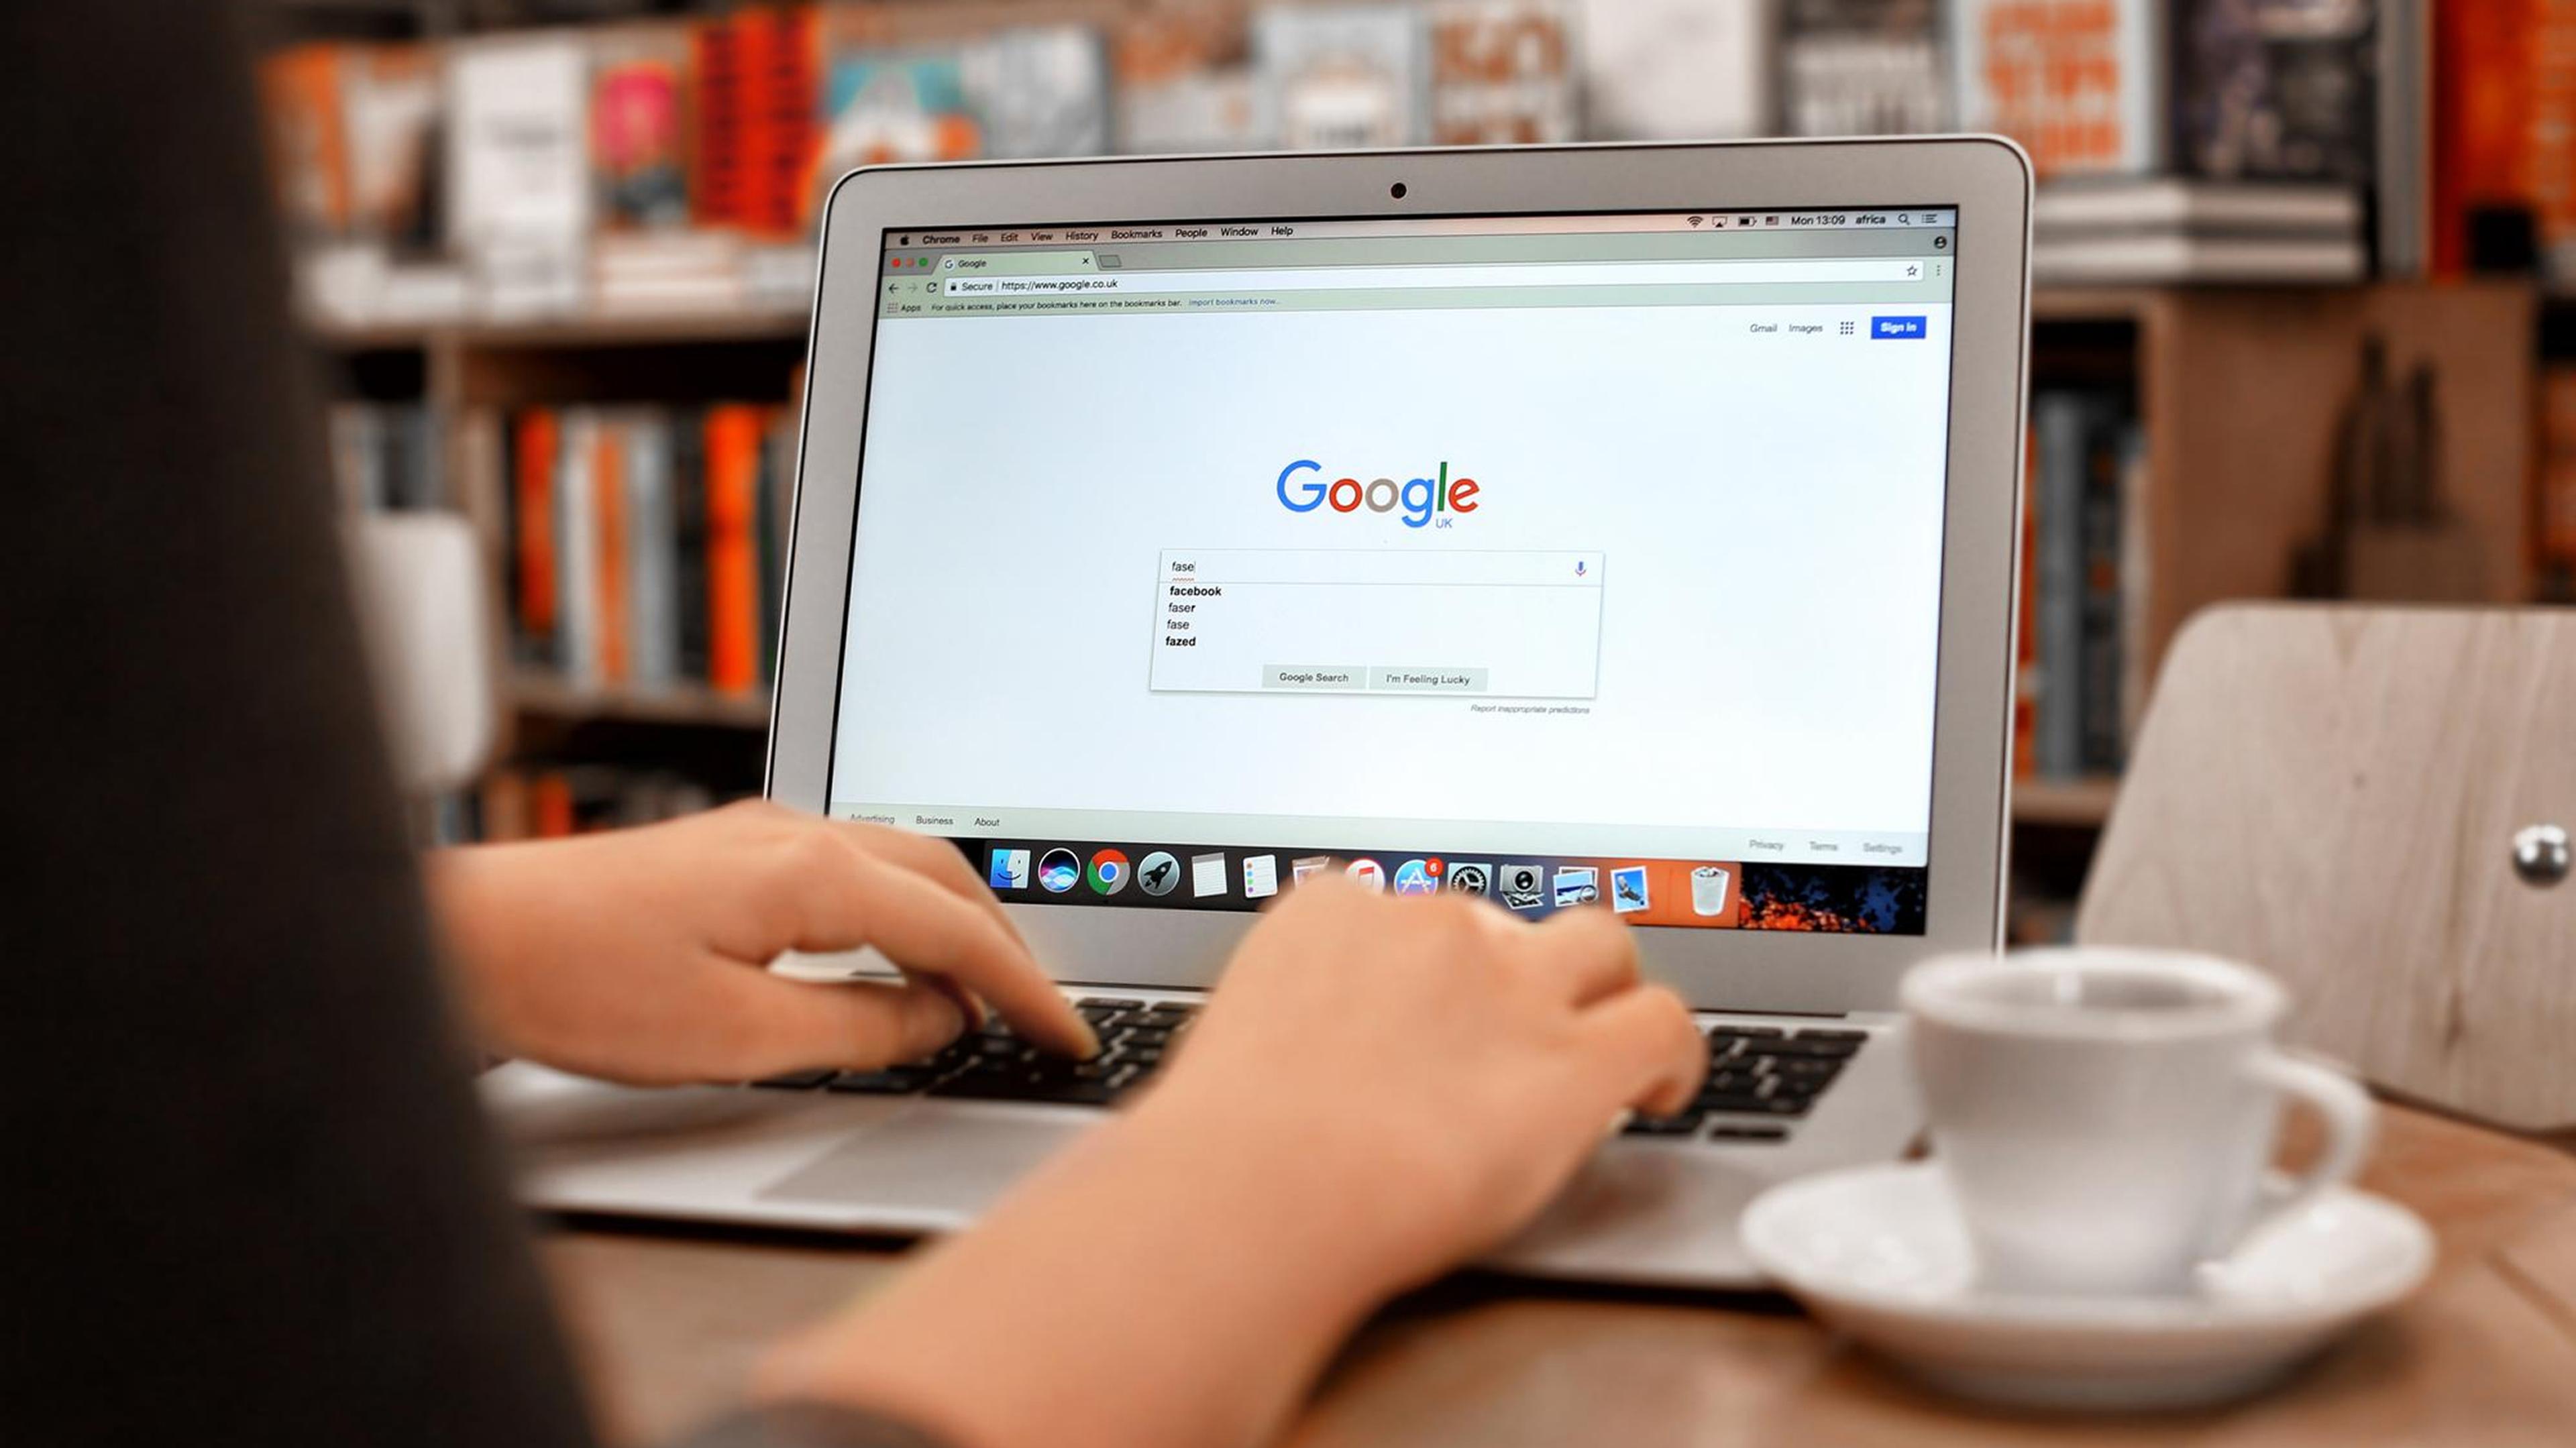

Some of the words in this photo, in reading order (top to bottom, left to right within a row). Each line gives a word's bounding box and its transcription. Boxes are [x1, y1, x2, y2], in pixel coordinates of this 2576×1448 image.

[1791, 216, 1814, 225] Mon
[1816, 215, 1845, 225] 13:09
[1856, 215, 1886, 225] africa
[922, 235, 961, 244] Chrome
[973, 234, 988, 243] File
[1001, 233, 1018, 242] Edit
[1031, 233, 1053, 241] View
[1065, 231, 1098, 242] History
[1111, 229, 1163, 239] Bookmarks
[1175, 229, 1208, 239] People
[1221, 227, 1258, 237] Window
[1271, 227, 1293, 236] Help
[958, 260, 987, 269] Google
[962, 282, 993, 291] Secure
[1002, 280, 1118, 291] https://www.google.co.uk
[900, 304, 921, 313] Apps
[945, 304, 964, 312] quick
[996, 302, 1016, 311] place
[1018, 303, 1035, 311] your
[1037, 301, 1078, 309] bookmarks
[1124, 300, 1166, 308] bookmarks
[1750, 323, 1778, 333] Gmail
[1788, 323, 1823, 335] Images
[1880, 322, 1902, 334] Sign
[1904, 322, 1917, 332] in
[1277, 459, 1480, 528] Google
[1436, 518, 1452, 528] UK
[1171, 561, 1195, 572] fase
[1169, 585, 1222, 597] facebook
[1168, 602, 1195, 613] faser
[1167, 618, 1189, 630] fase
[1165, 635, 1196, 647] fazed
[1279, 671, 1313, 683] Google
[1316, 672, 1349, 683] Search
[1386, 674, 1400, 683] I'm
[1403, 674, 1438, 685] Feeling
[1440, 675, 1471, 686] Lucky
[1471, 704, 1496, 713] Report
[1548, 706, 1590, 715] predictions
[850, 814, 895, 825] Advertising
[916, 816, 953, 826] Business
[975, 818, 1000, 826] About
[1750, 839, 1784, 851] Privacy
[1809, 840, 1838, 851] Terms
[1863, 842, 1903, 855] Settings
